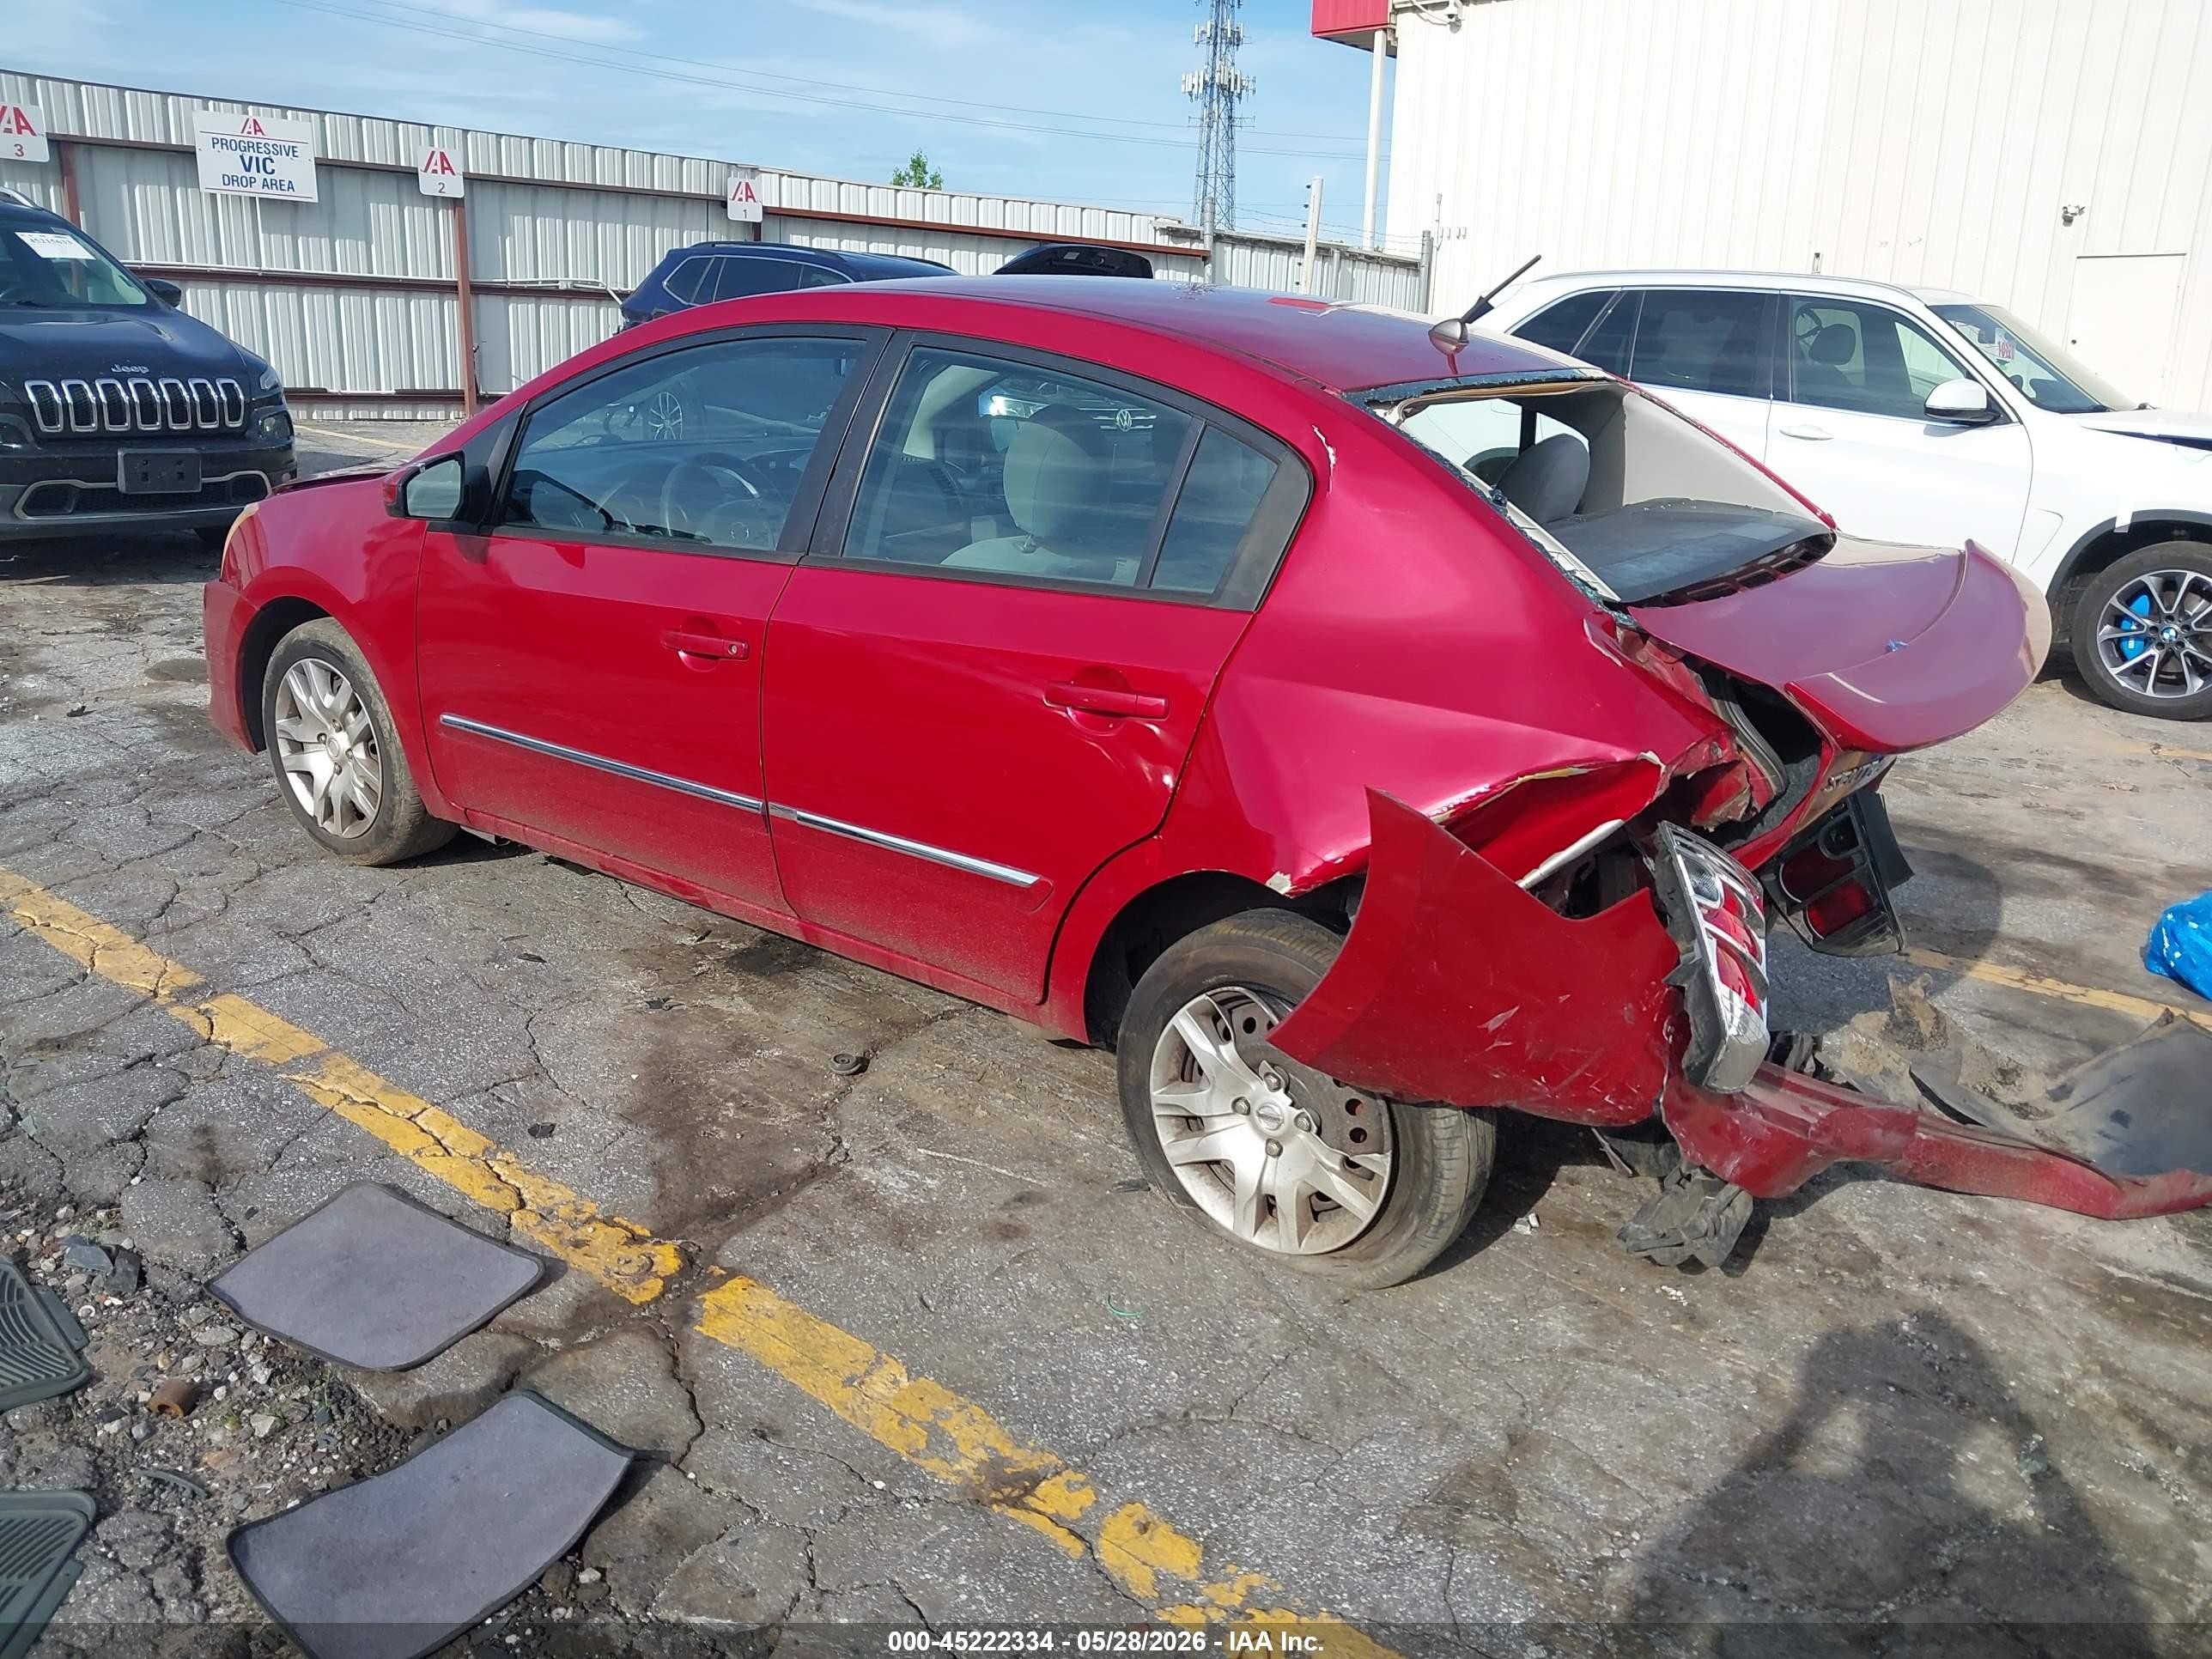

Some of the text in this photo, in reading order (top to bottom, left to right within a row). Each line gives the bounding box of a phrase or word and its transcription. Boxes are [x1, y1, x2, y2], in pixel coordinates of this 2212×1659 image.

[14, 143, 24, 157] 3
[211, 137, 299, 158] PROGRESSIVE
[239, 155, 276, 175] VIC
[222, 173, 295, 192] DROP AREA
[438, 182, 446, 194] 2
[743, 209, 747, 219] 1
[111, 363, 149, 374] Jeep
